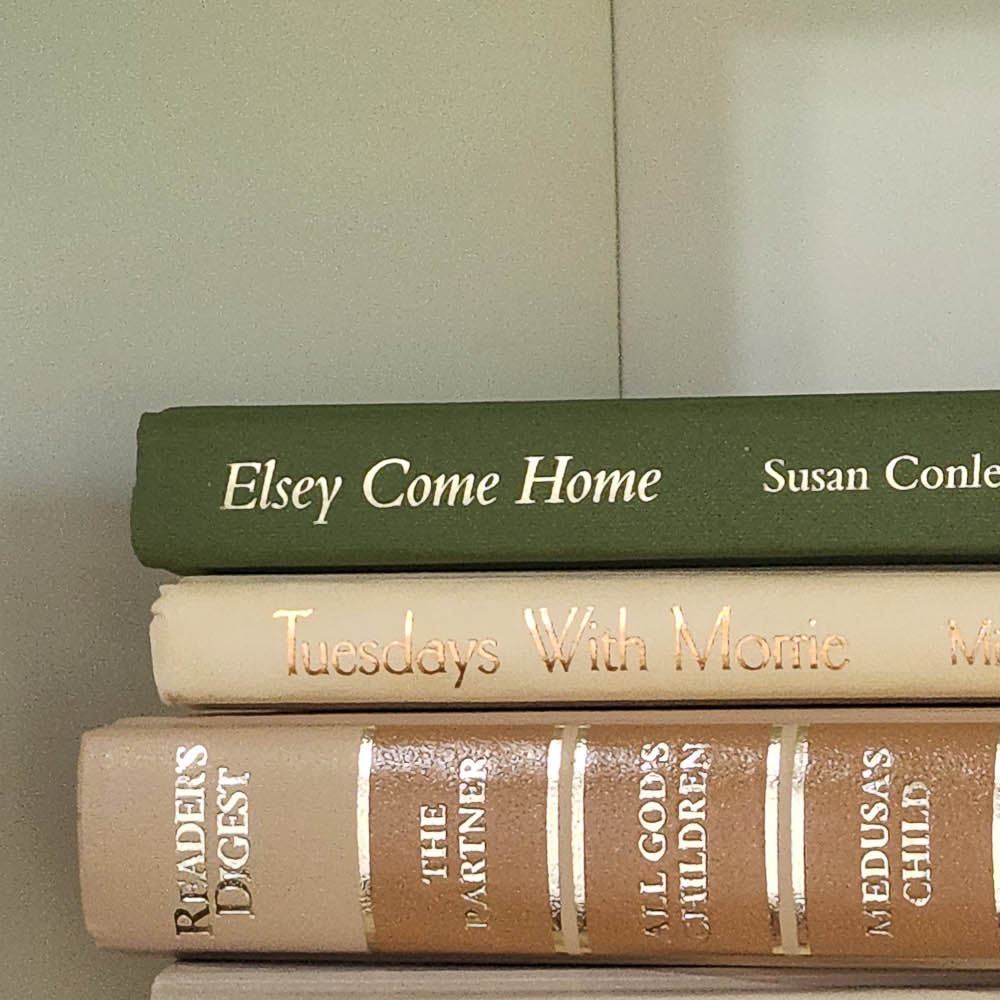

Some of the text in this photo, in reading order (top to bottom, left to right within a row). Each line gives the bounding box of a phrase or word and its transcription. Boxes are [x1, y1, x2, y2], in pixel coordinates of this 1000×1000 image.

[219, 454, 662, 526] Elsey Come Home
[762, 457, 870, 494] Susan
[272, 604, 850, 689] Tuesdays With Morrie
[174, 743, 214, 937] READER'S
[214, 766, 256, 920] DIGEST
[419, 804, 448, 885] THE
[457, 757, 491, 931] PARTNER
[637, 741, 670, 863] GOD'S
[859, 746, 894, 937] MEDUSA'S
[901, 780, 934, 908] CHILD
